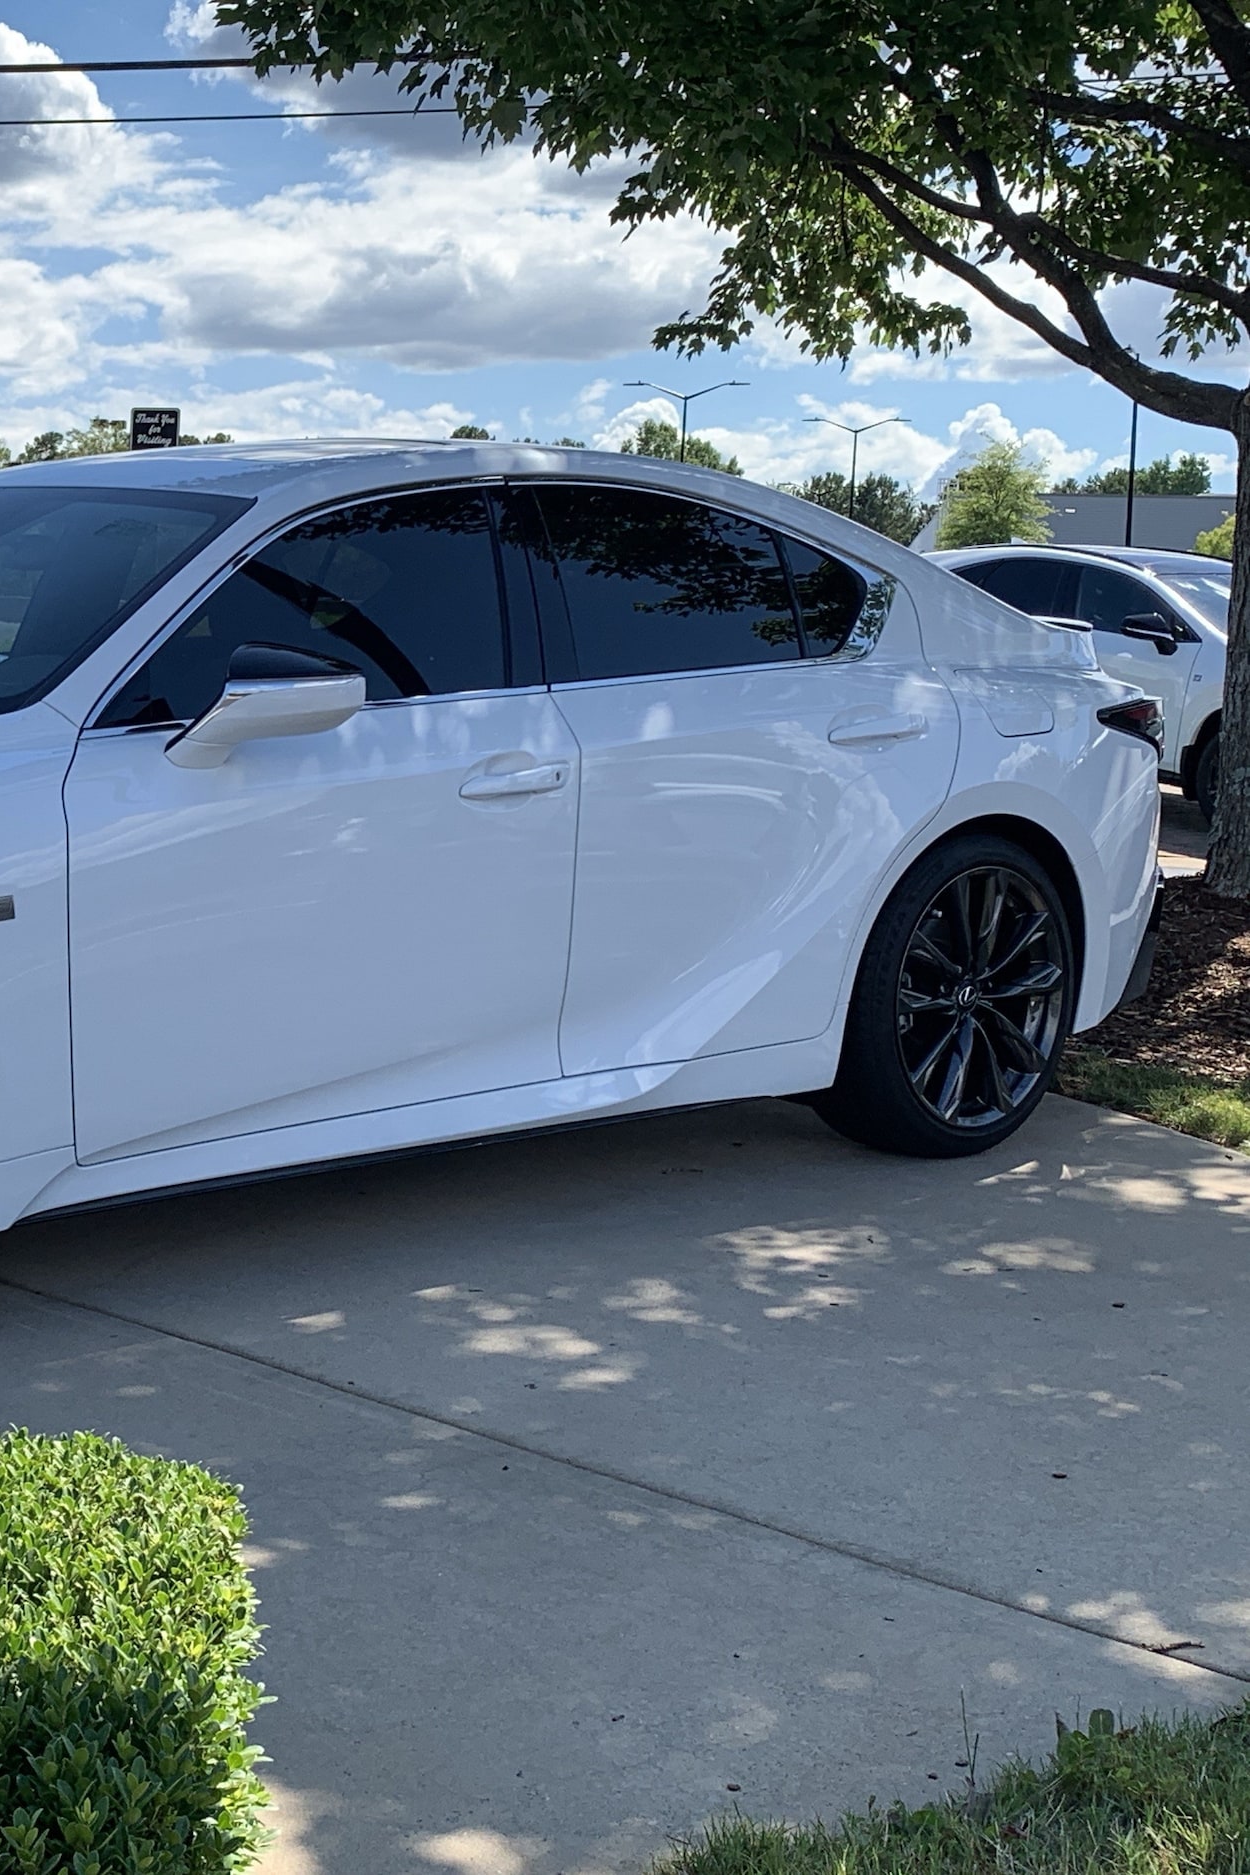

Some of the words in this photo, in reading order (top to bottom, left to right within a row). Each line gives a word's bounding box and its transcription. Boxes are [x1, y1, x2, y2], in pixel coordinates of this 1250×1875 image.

[135, 413, 160, 424] Thank
[161, 414, 175, 427] You
[148, 425, 161, 435] for
[137, 434, 171, 447] Visiting
